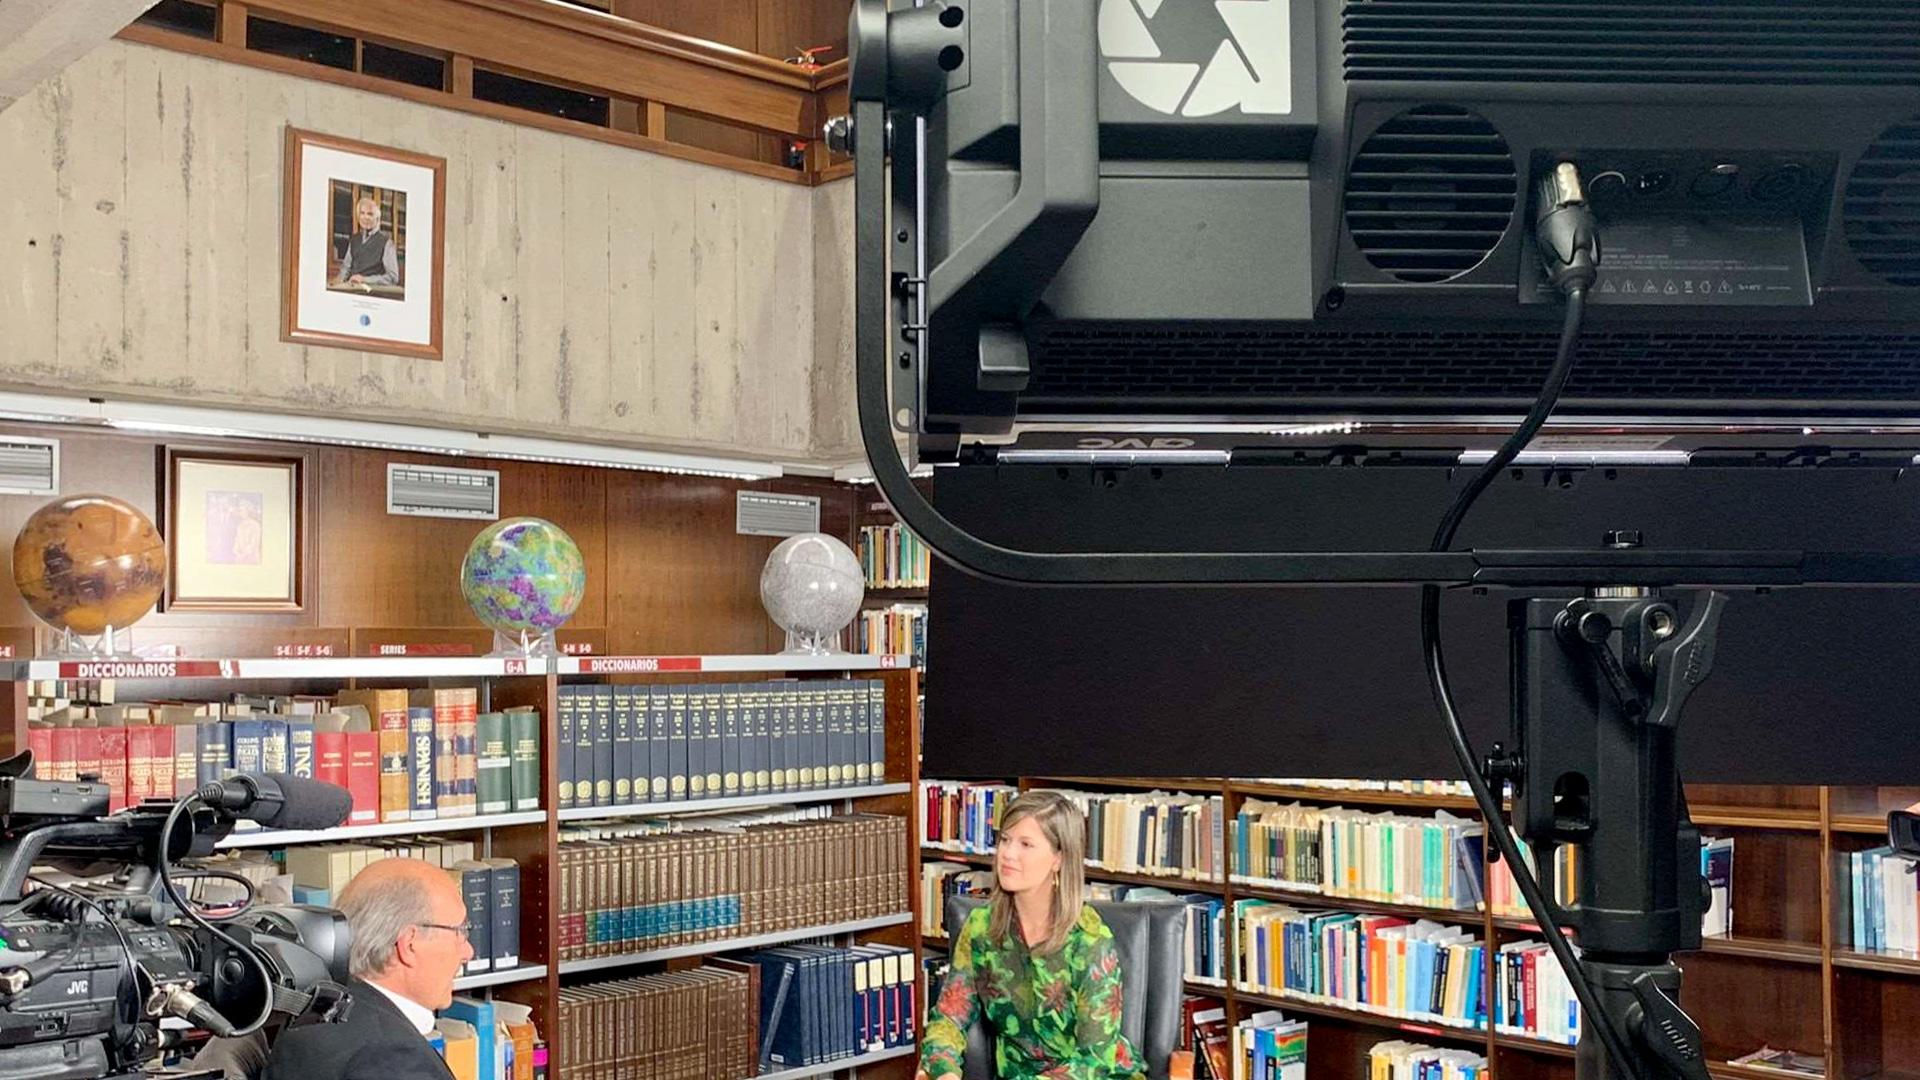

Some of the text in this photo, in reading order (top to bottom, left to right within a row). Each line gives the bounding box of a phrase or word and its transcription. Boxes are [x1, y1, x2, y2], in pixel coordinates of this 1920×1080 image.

[380, 645, 407, 655] SERIES
[78, 663, 176, 678] DICCIONARIOS
[507, 661, 524, 673] G-A
[591, 659, 658, 671] DICCIONARIOS
[294, 746, 311, 779] ING
[416, 735, 431, 805] SPANISH
[67, 980, 89, 995] JVC
